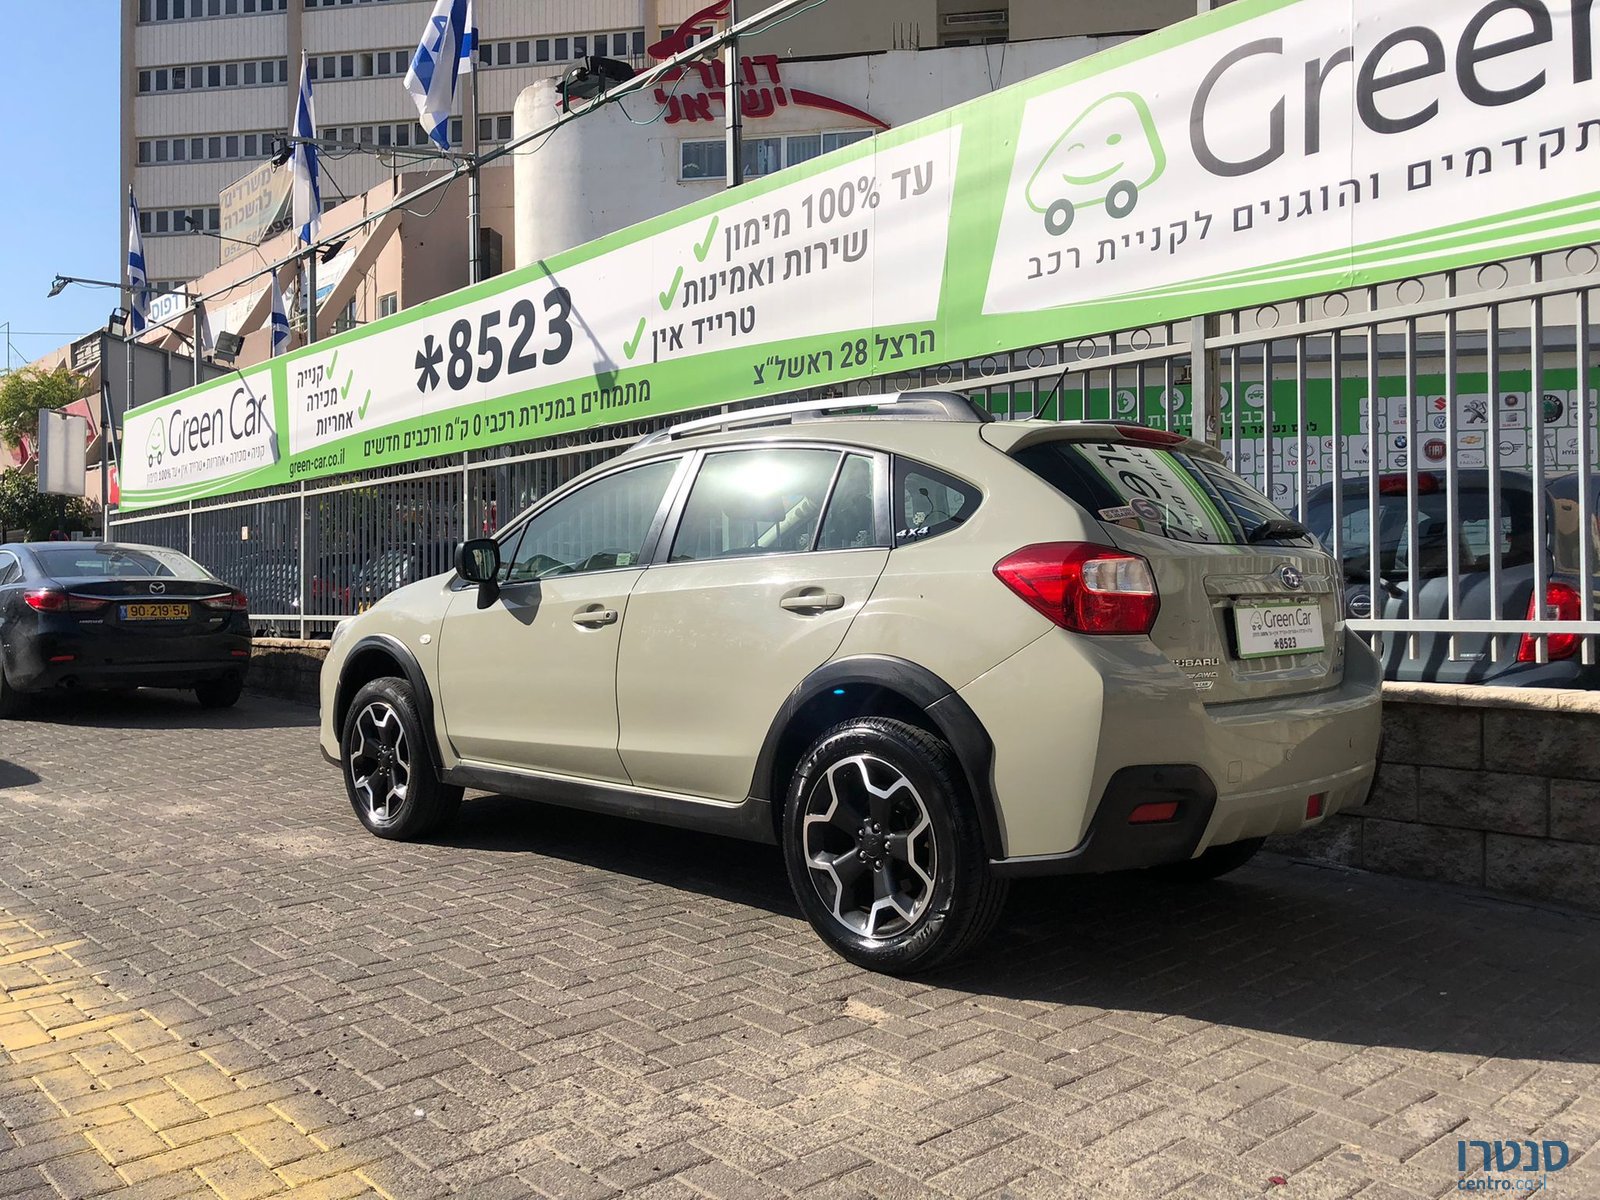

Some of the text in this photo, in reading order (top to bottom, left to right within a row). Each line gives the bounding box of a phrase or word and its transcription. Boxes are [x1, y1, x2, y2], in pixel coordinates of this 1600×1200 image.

[223, 188, 272, 231] להשכרה
[725, 160, 934, 262] עד 100% מימון
[1233, 173, 1379, 233] והוגנים
[1096, 209, 1213, 264] לקניית
[682, 228, 868, 308] שירות ואמינות
[1028, 246, 1081, 280] רכב
[652, 305, 756, 363] טרייד אין
[875, 329, 936, 361] הרצל
[840, 338, 868, 369] 28
[297, 364, 324, 388] קנייה
[306, 388, 338, 412] מכירה
[581, 379, 651, 414] מתמחים
[169, 387, 267, 457] Green Car
[316, 410, 354, 436] אחריות
[473, 413, 481, 436] 0
[484, 411, 515, 434] רכבי
[518, 398, 576, 428] במכירת
[363, 434, 400, 457] חדשים
[403, 426, 441, 449] ורכבים
[289, 448, 345, 478] green-car.co.il
[1263, 608, 1312, 628] Green Car
